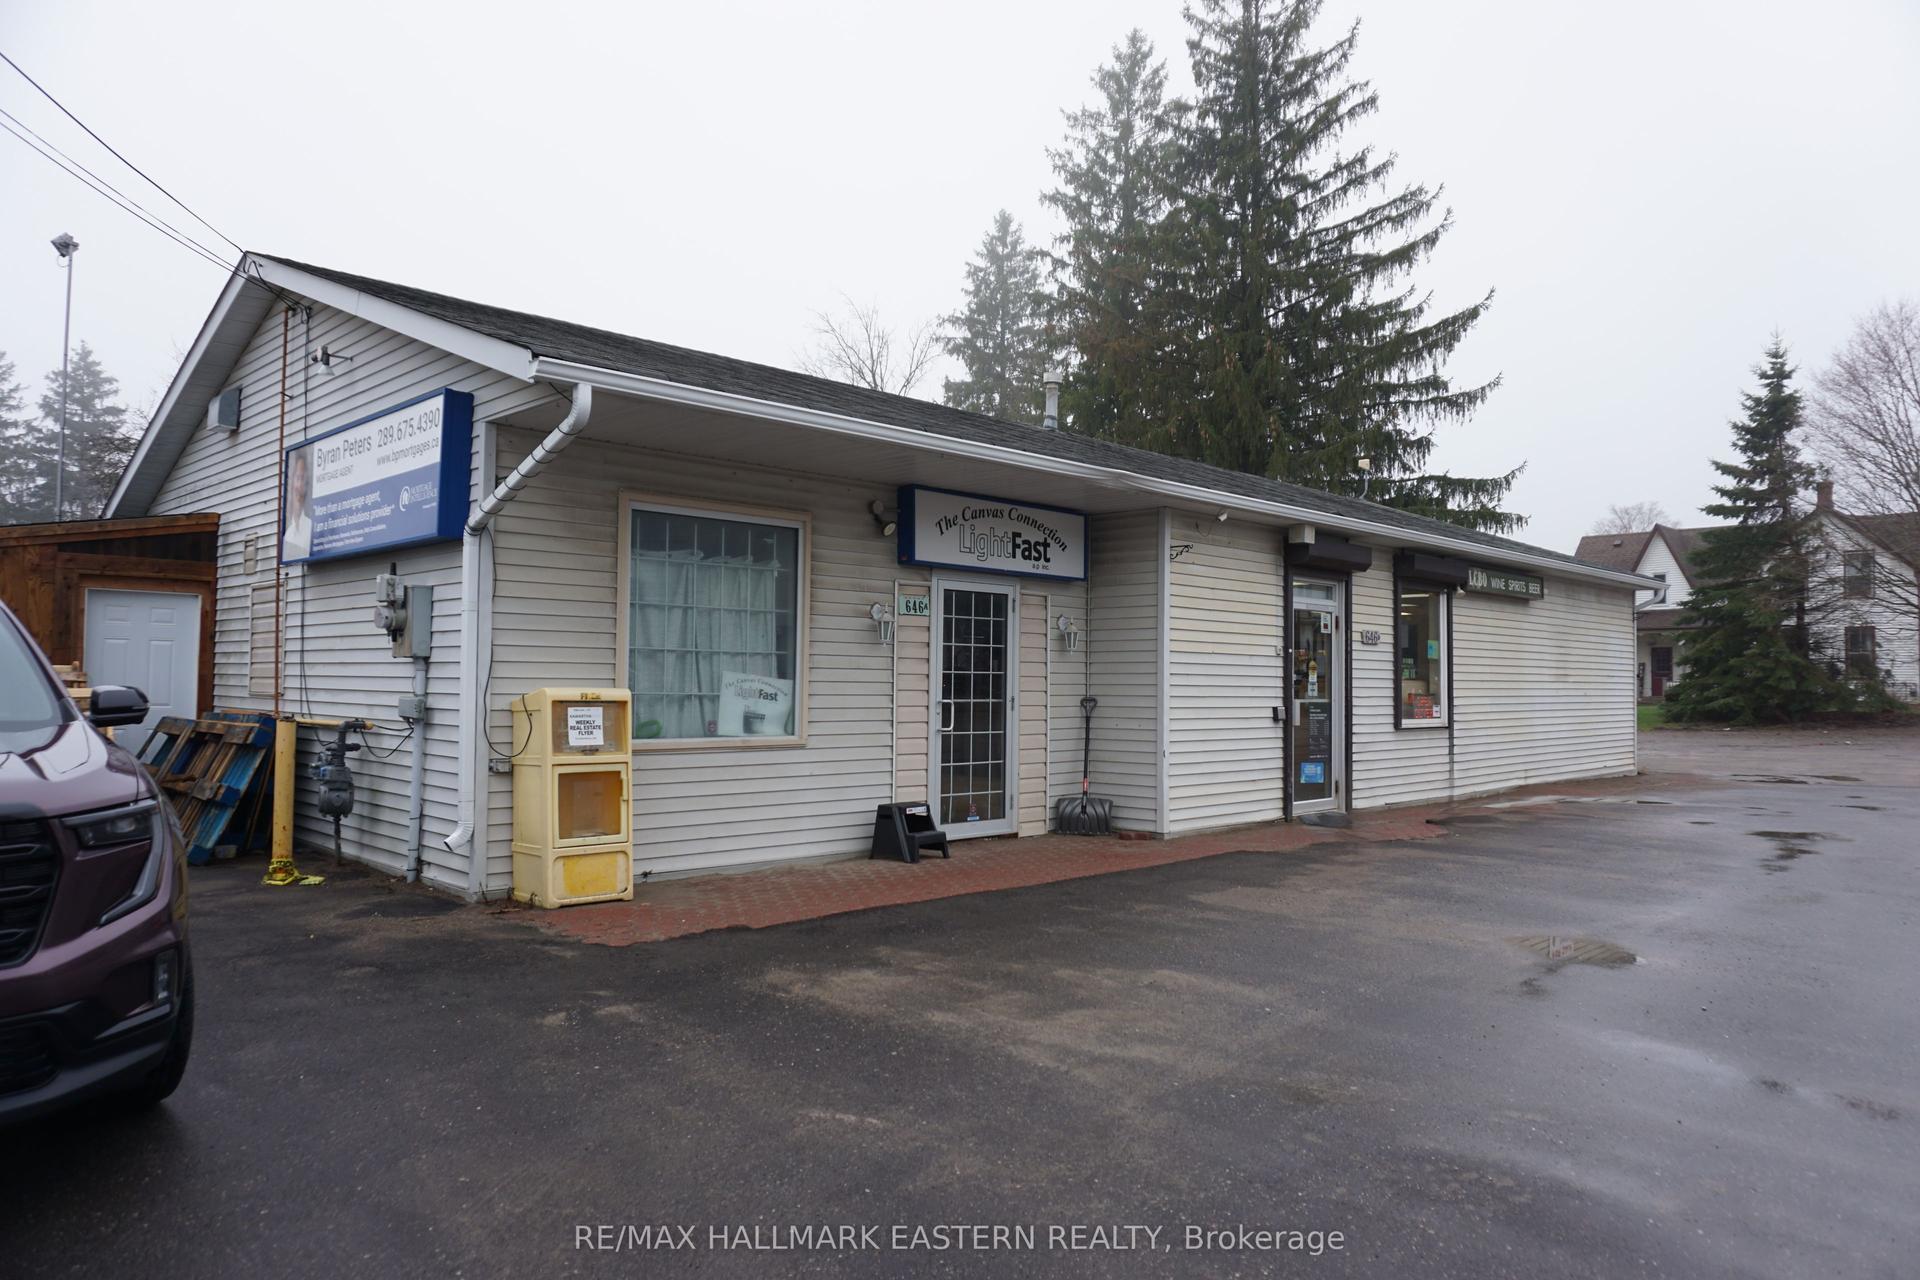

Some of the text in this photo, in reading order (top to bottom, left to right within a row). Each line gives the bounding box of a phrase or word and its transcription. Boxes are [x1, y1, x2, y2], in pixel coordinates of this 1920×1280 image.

[377, 407, 440, 448] 289.675.4390
[316, 435, 372, 471] Byran Peters
[935, 506, 1069, 552] The Canvas Connection
[960, 523, 1051, 563] LightFast
[1468, 569, 1540, 594] LCBO WINE SPIRITS BEER
